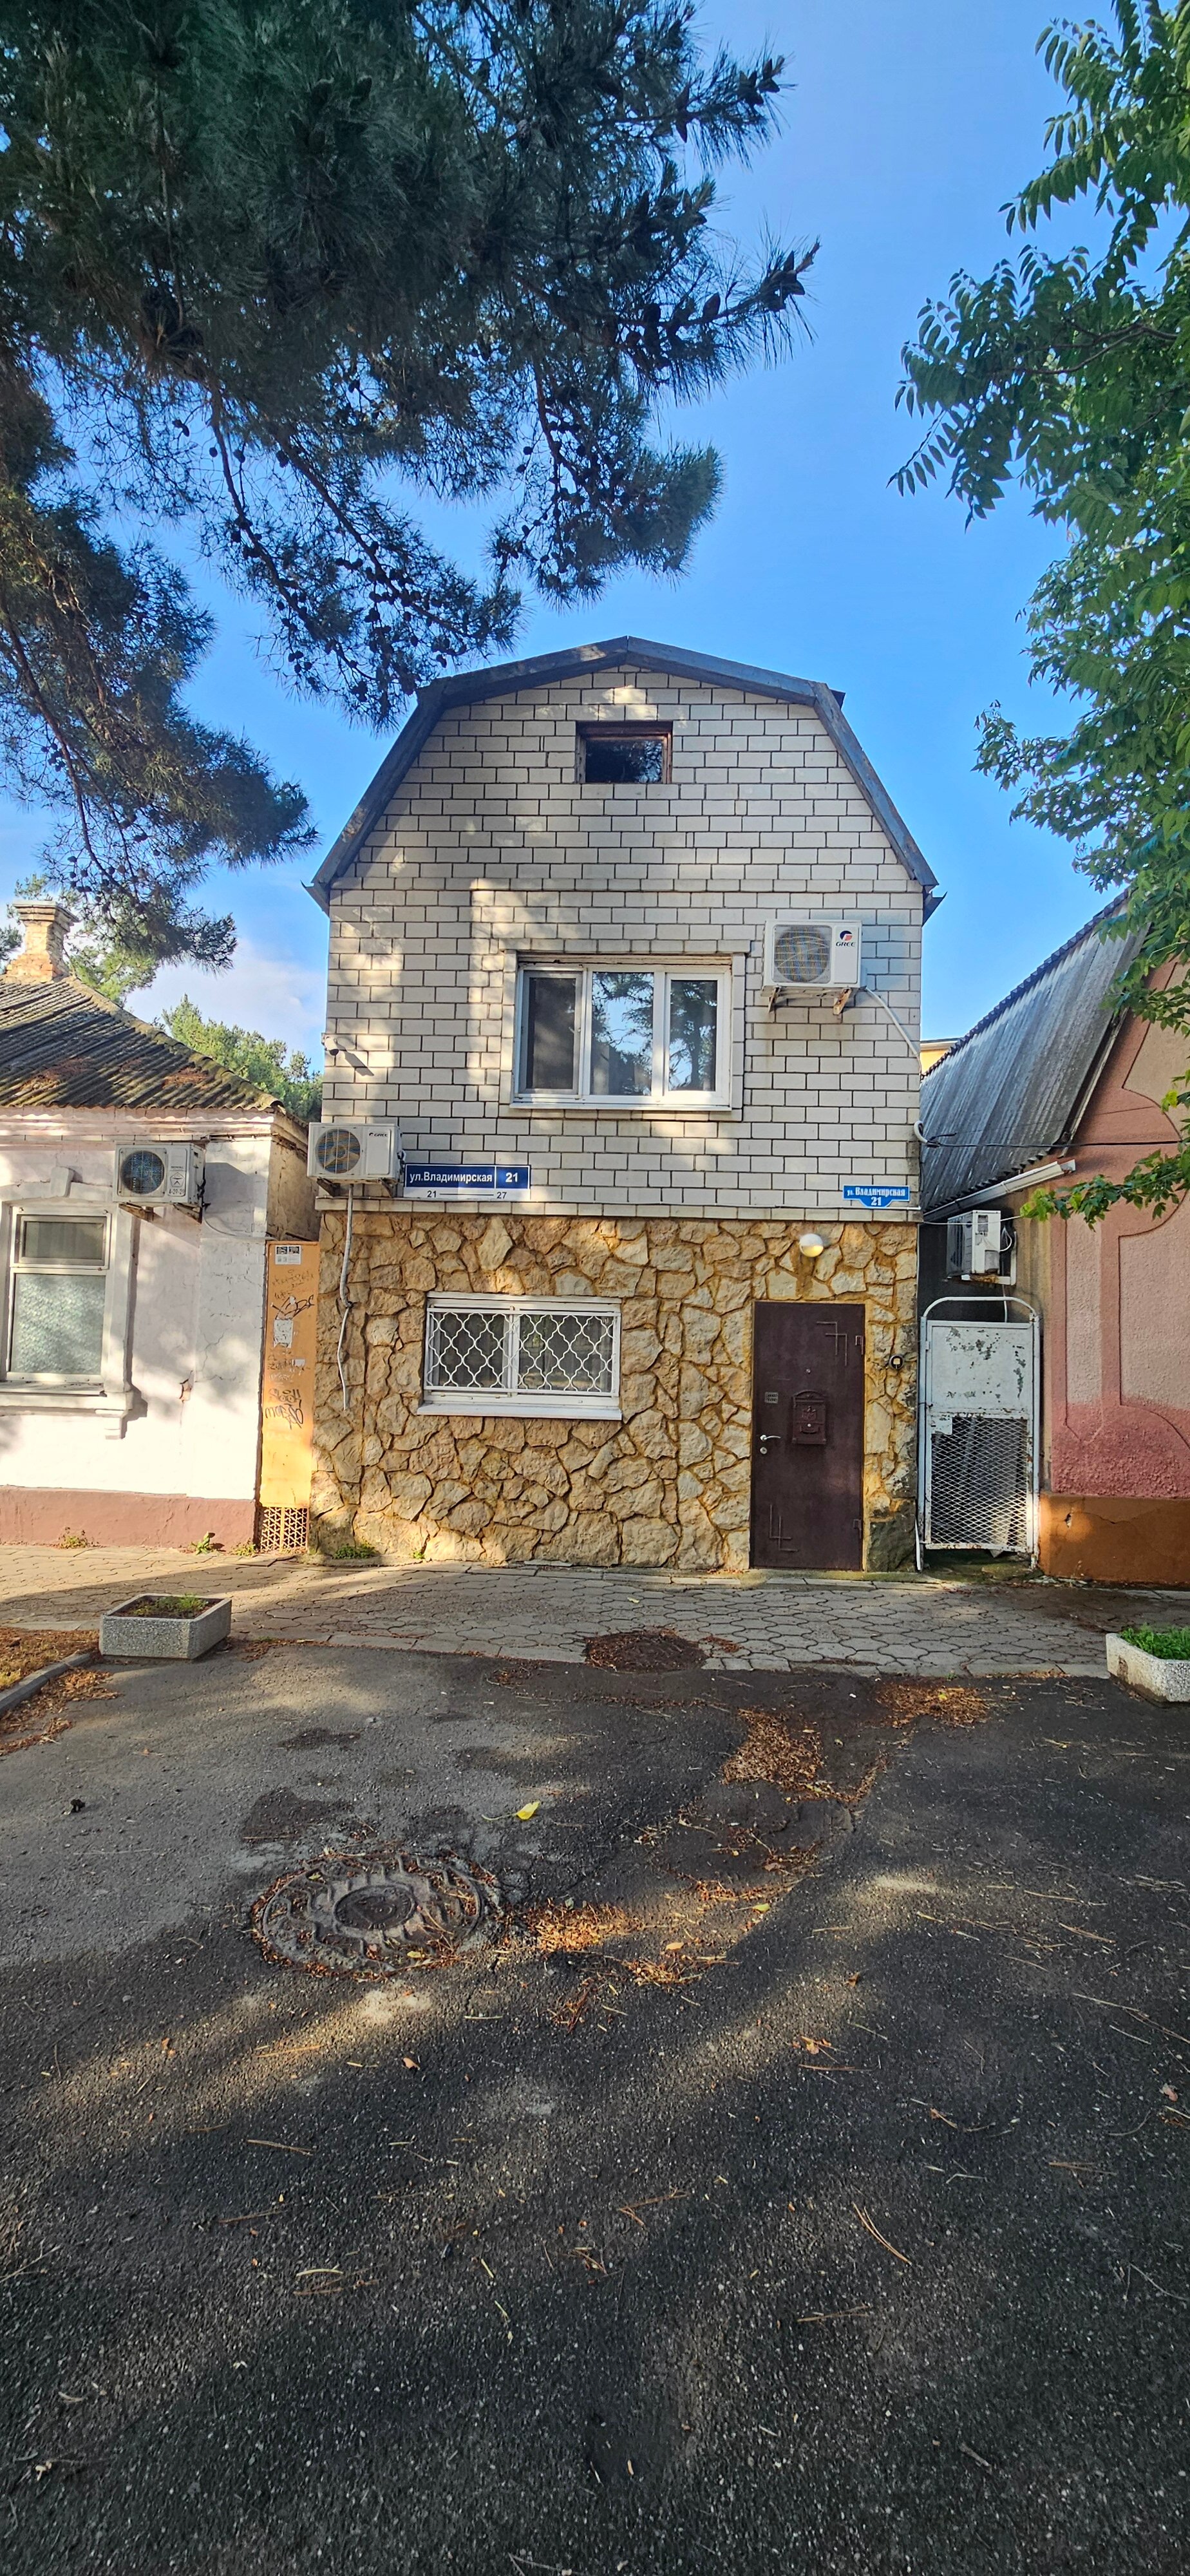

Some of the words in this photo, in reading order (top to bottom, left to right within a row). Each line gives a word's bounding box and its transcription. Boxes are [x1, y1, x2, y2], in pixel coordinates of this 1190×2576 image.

[410, 1171, 493, 1184] ул.Владимирская
[505, 1172, 518, 1183] 21
[427, 1190, 437, 1198] 21
[855, 1187, 905, 1197] Владимирская
[871, 1197, 882, 1206] 21
